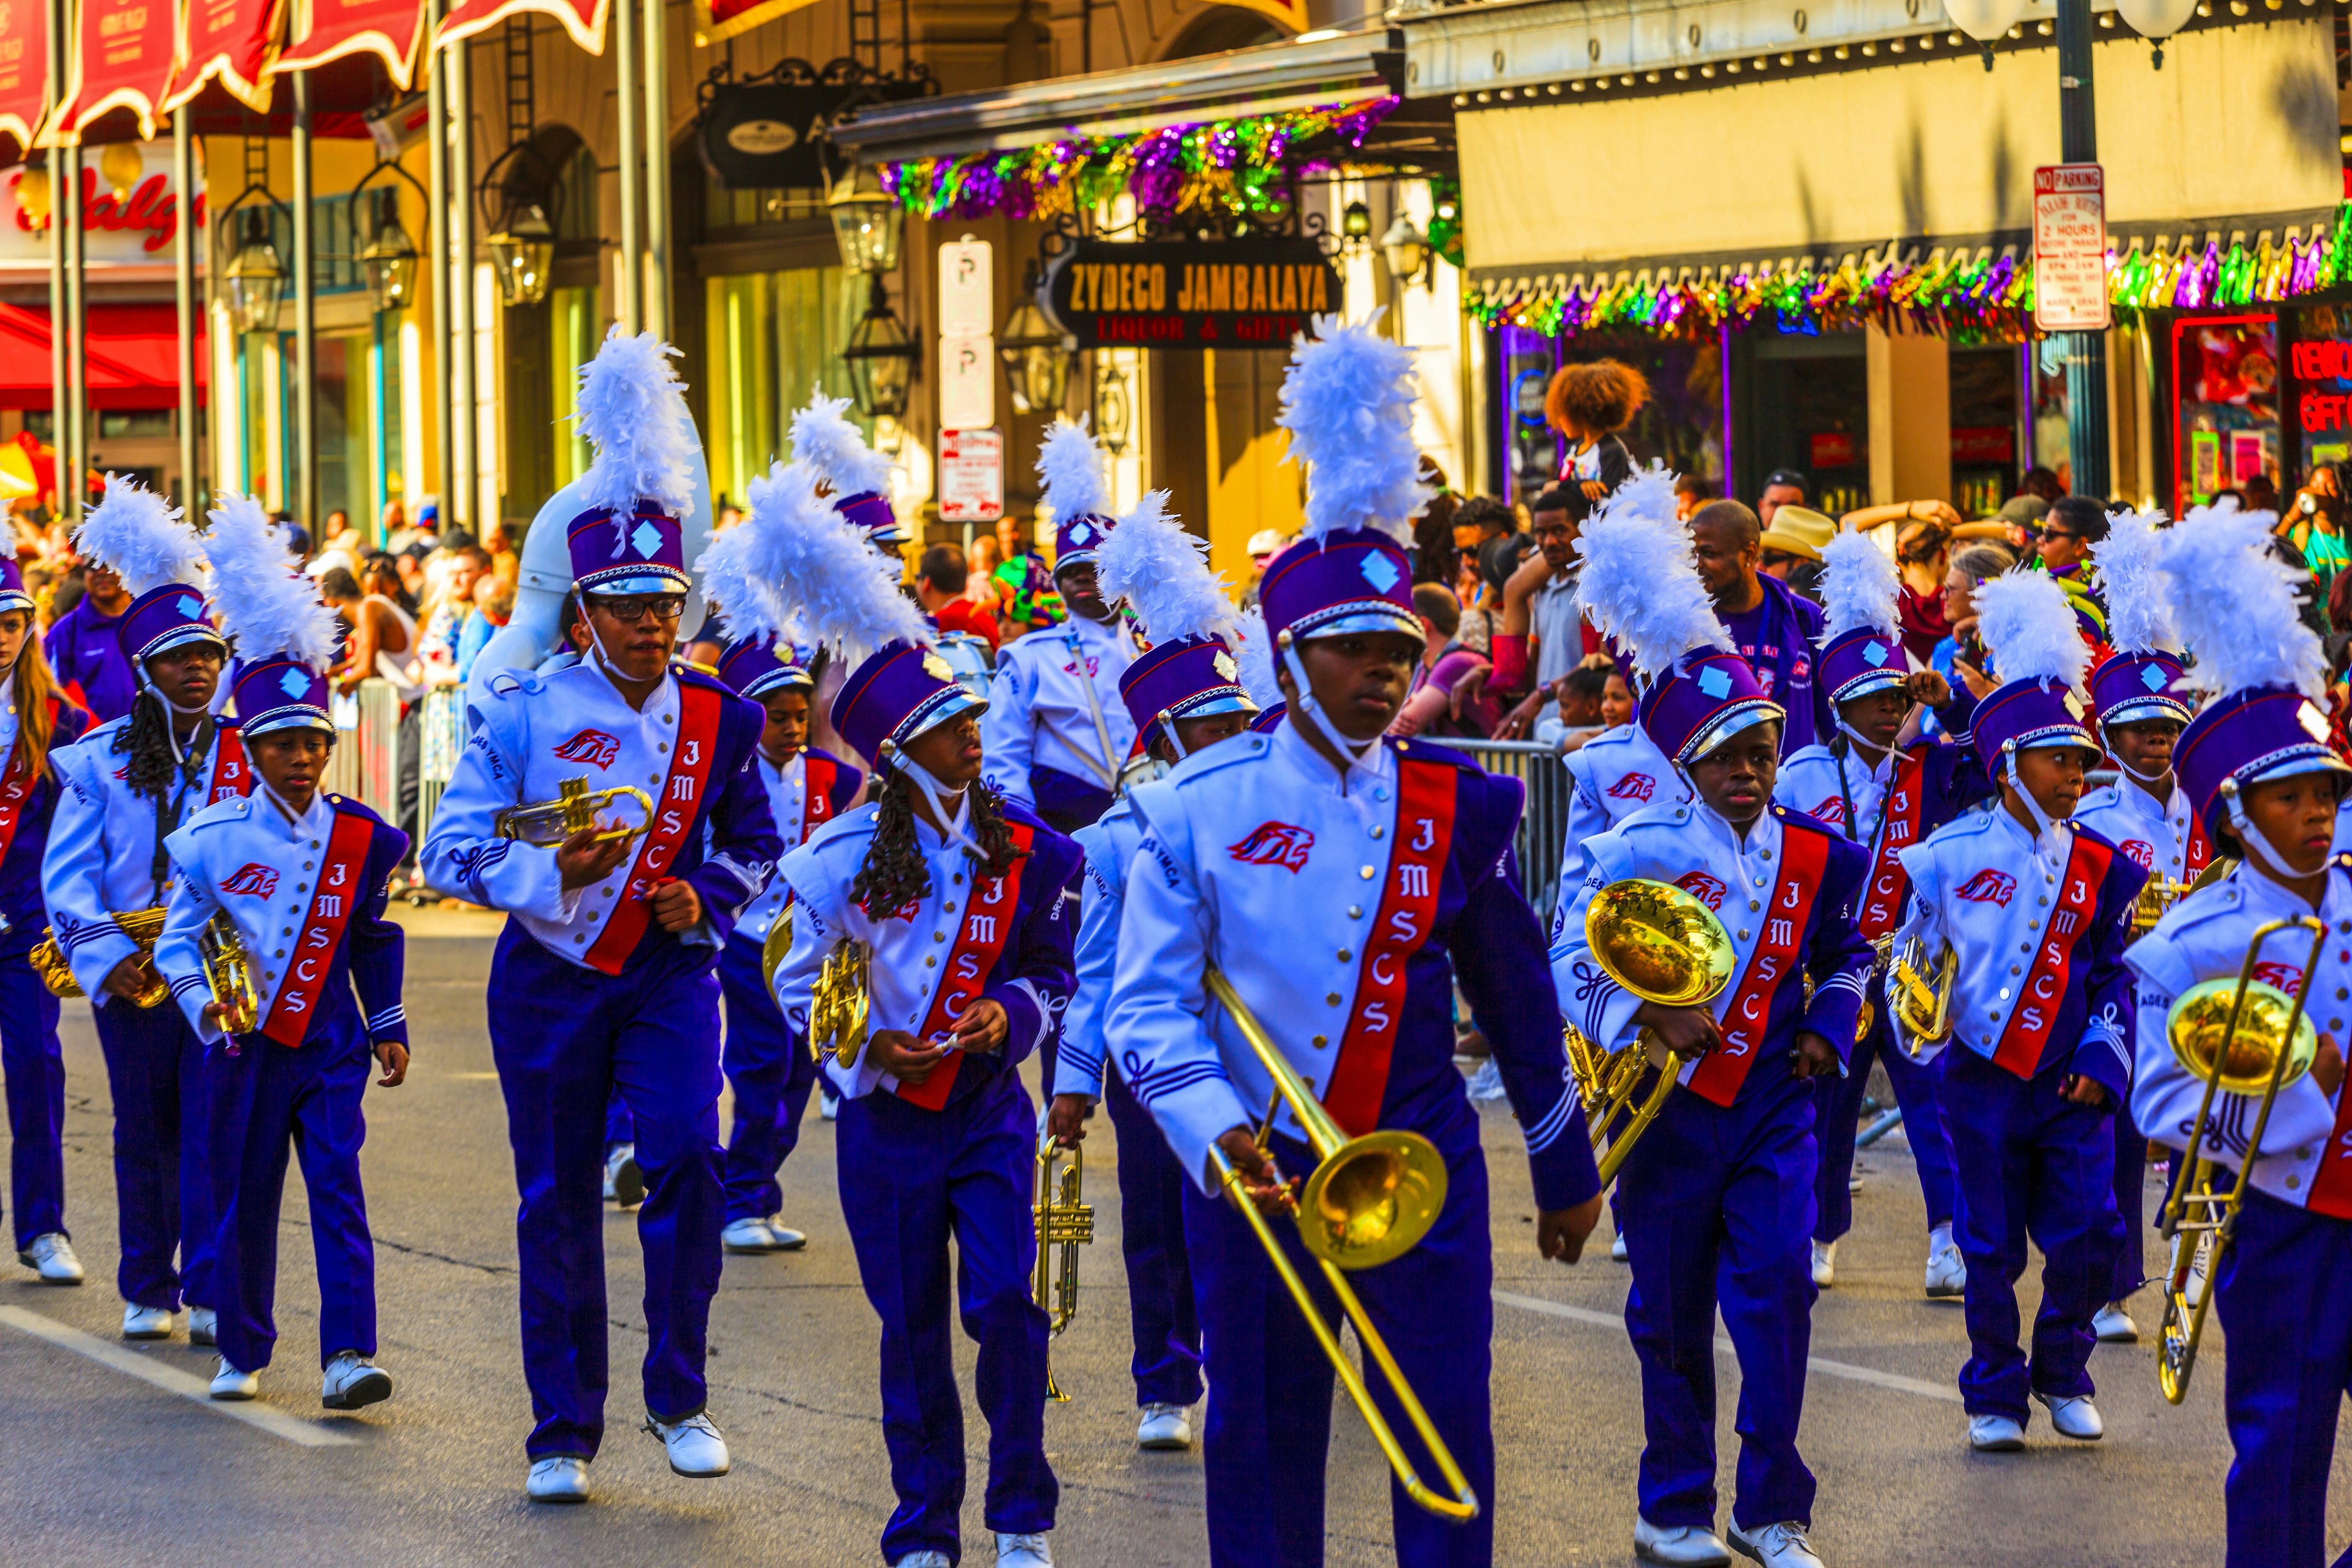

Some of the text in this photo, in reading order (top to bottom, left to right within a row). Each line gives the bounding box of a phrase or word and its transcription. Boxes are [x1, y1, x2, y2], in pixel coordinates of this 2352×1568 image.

[2036, 171, 2099, 189] NO PARKING
[2043, 224, 2096, 237] 2 HOURS
[1070, 263, 1328, 312] ZYDECO JAMBALAYA
[1096, 316, 1186, 341] LIQUOR
[1199, 317, 1219, 340] &
[486, 747, 504, 780] YMCA
[1156, 847, 1181, 889] YMCA
[183, 880, 204, 904] YMCA
[1093, 871, 1108, 900] YMCA
[806, 905, 825, 937] YMCA
[1364, 818, 1435, 1033] JMSCS
[284, 864, 347, 1014] JMSCS
[1723, 881, 1800, 1057] JMSCS
[2020, 880, 2086, 1032] JMSCS
